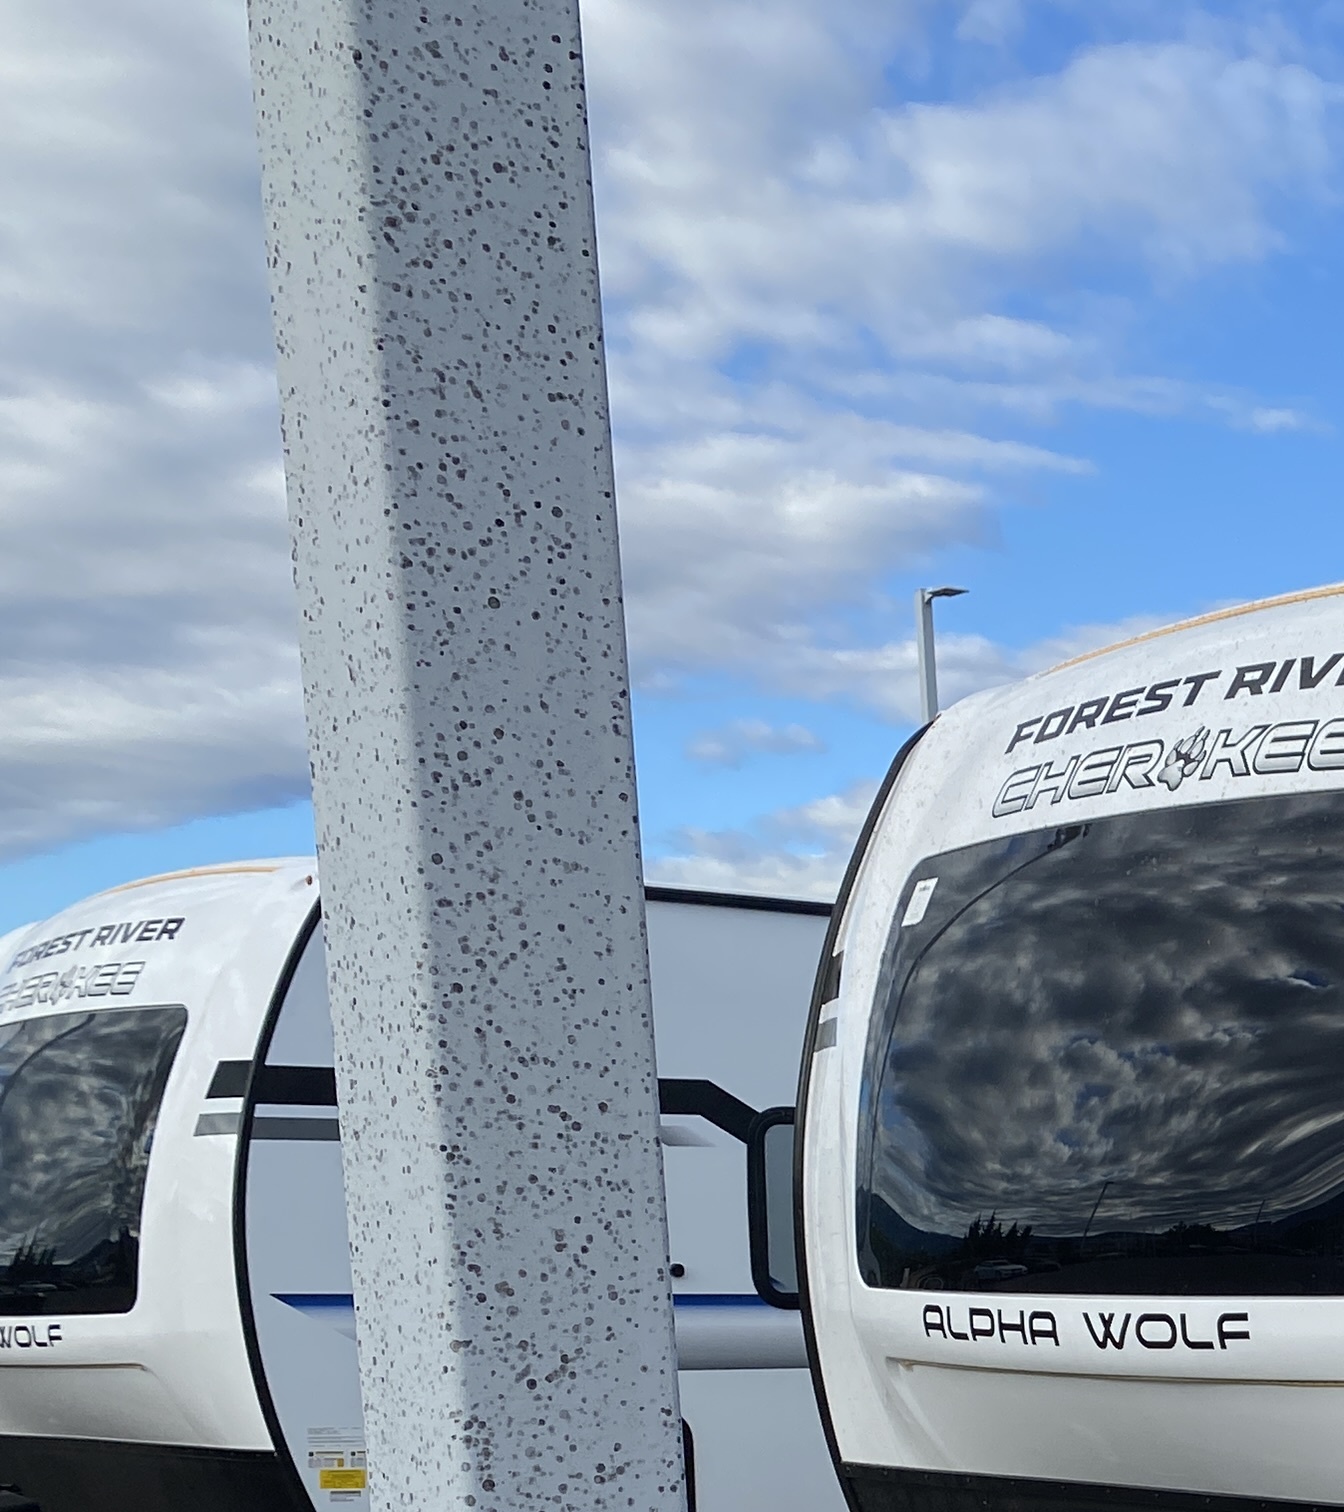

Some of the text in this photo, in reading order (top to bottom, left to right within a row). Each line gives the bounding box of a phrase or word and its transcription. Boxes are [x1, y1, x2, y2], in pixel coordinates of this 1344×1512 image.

[1004, 670, 1221, 754] FOREST
[6, 917, 186, 974] FOREST RIVER
[922, 1304, 1251, 1350] ALPHA WOLF
